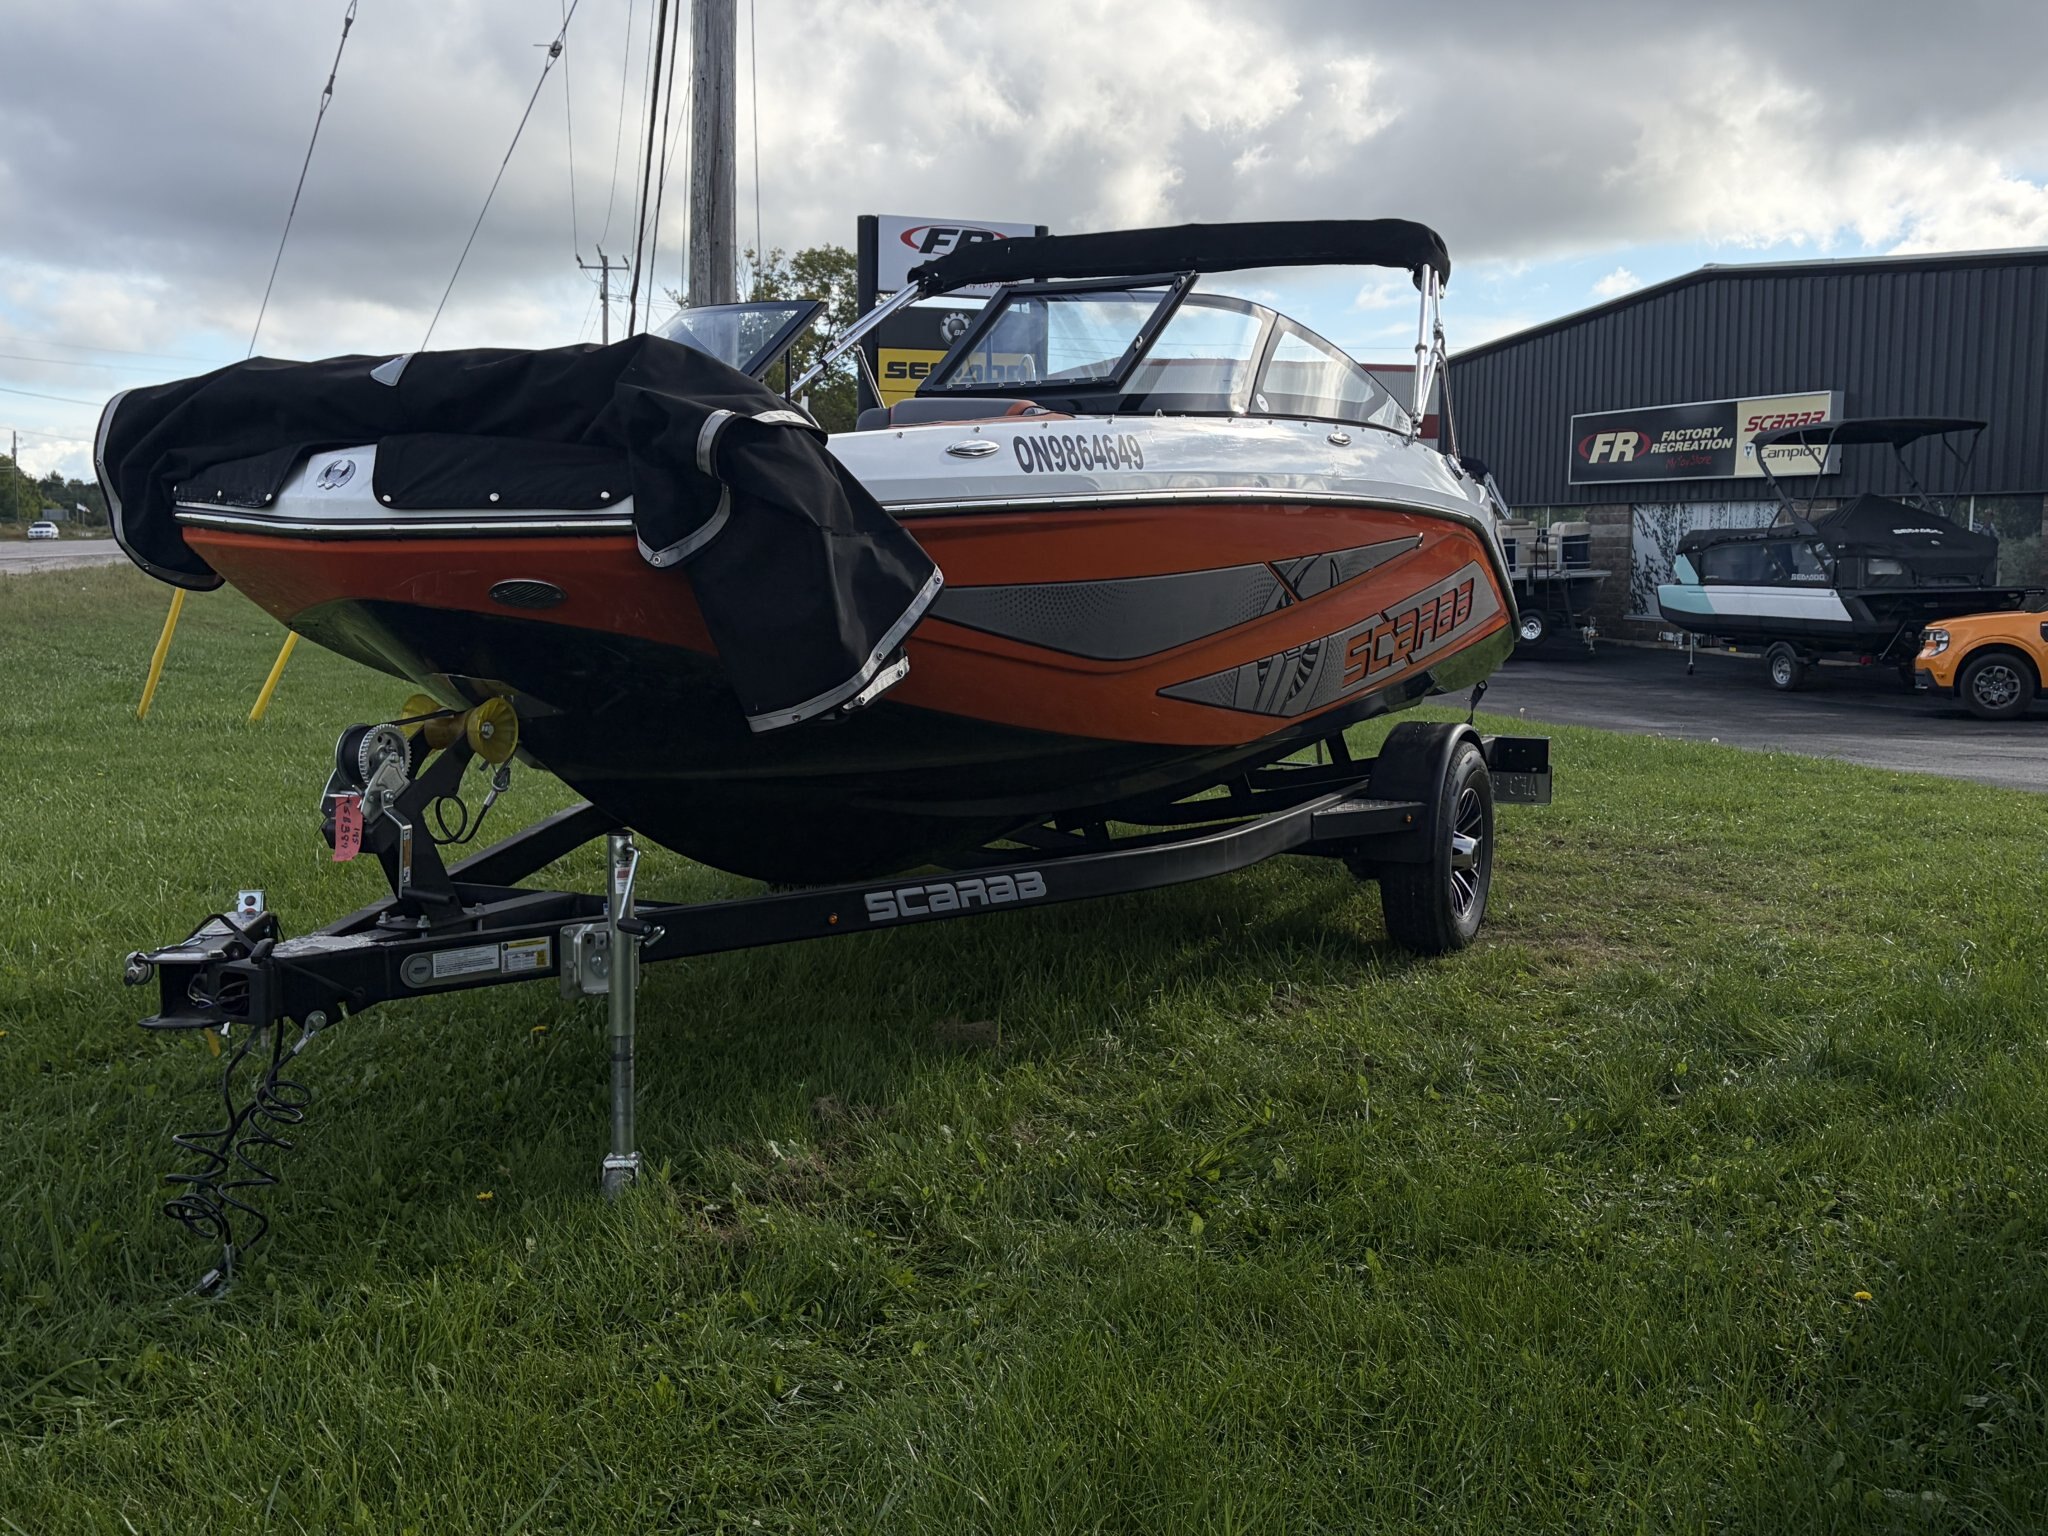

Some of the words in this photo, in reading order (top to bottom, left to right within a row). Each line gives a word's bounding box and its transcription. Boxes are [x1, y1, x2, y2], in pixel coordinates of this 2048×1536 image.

[1588, 431, 1639, 464] FR
[1650, 438, 1733, 454] RECREATION
[1661, 426, 1723, 441] FACTORY
[1012, 434, 1145, 474] ON9864649
[1760, 446, 1822, 461] Campion
[1342, 577, 1475, 689] SCARAB
[864, 871, 1047, 922] SCARAB
